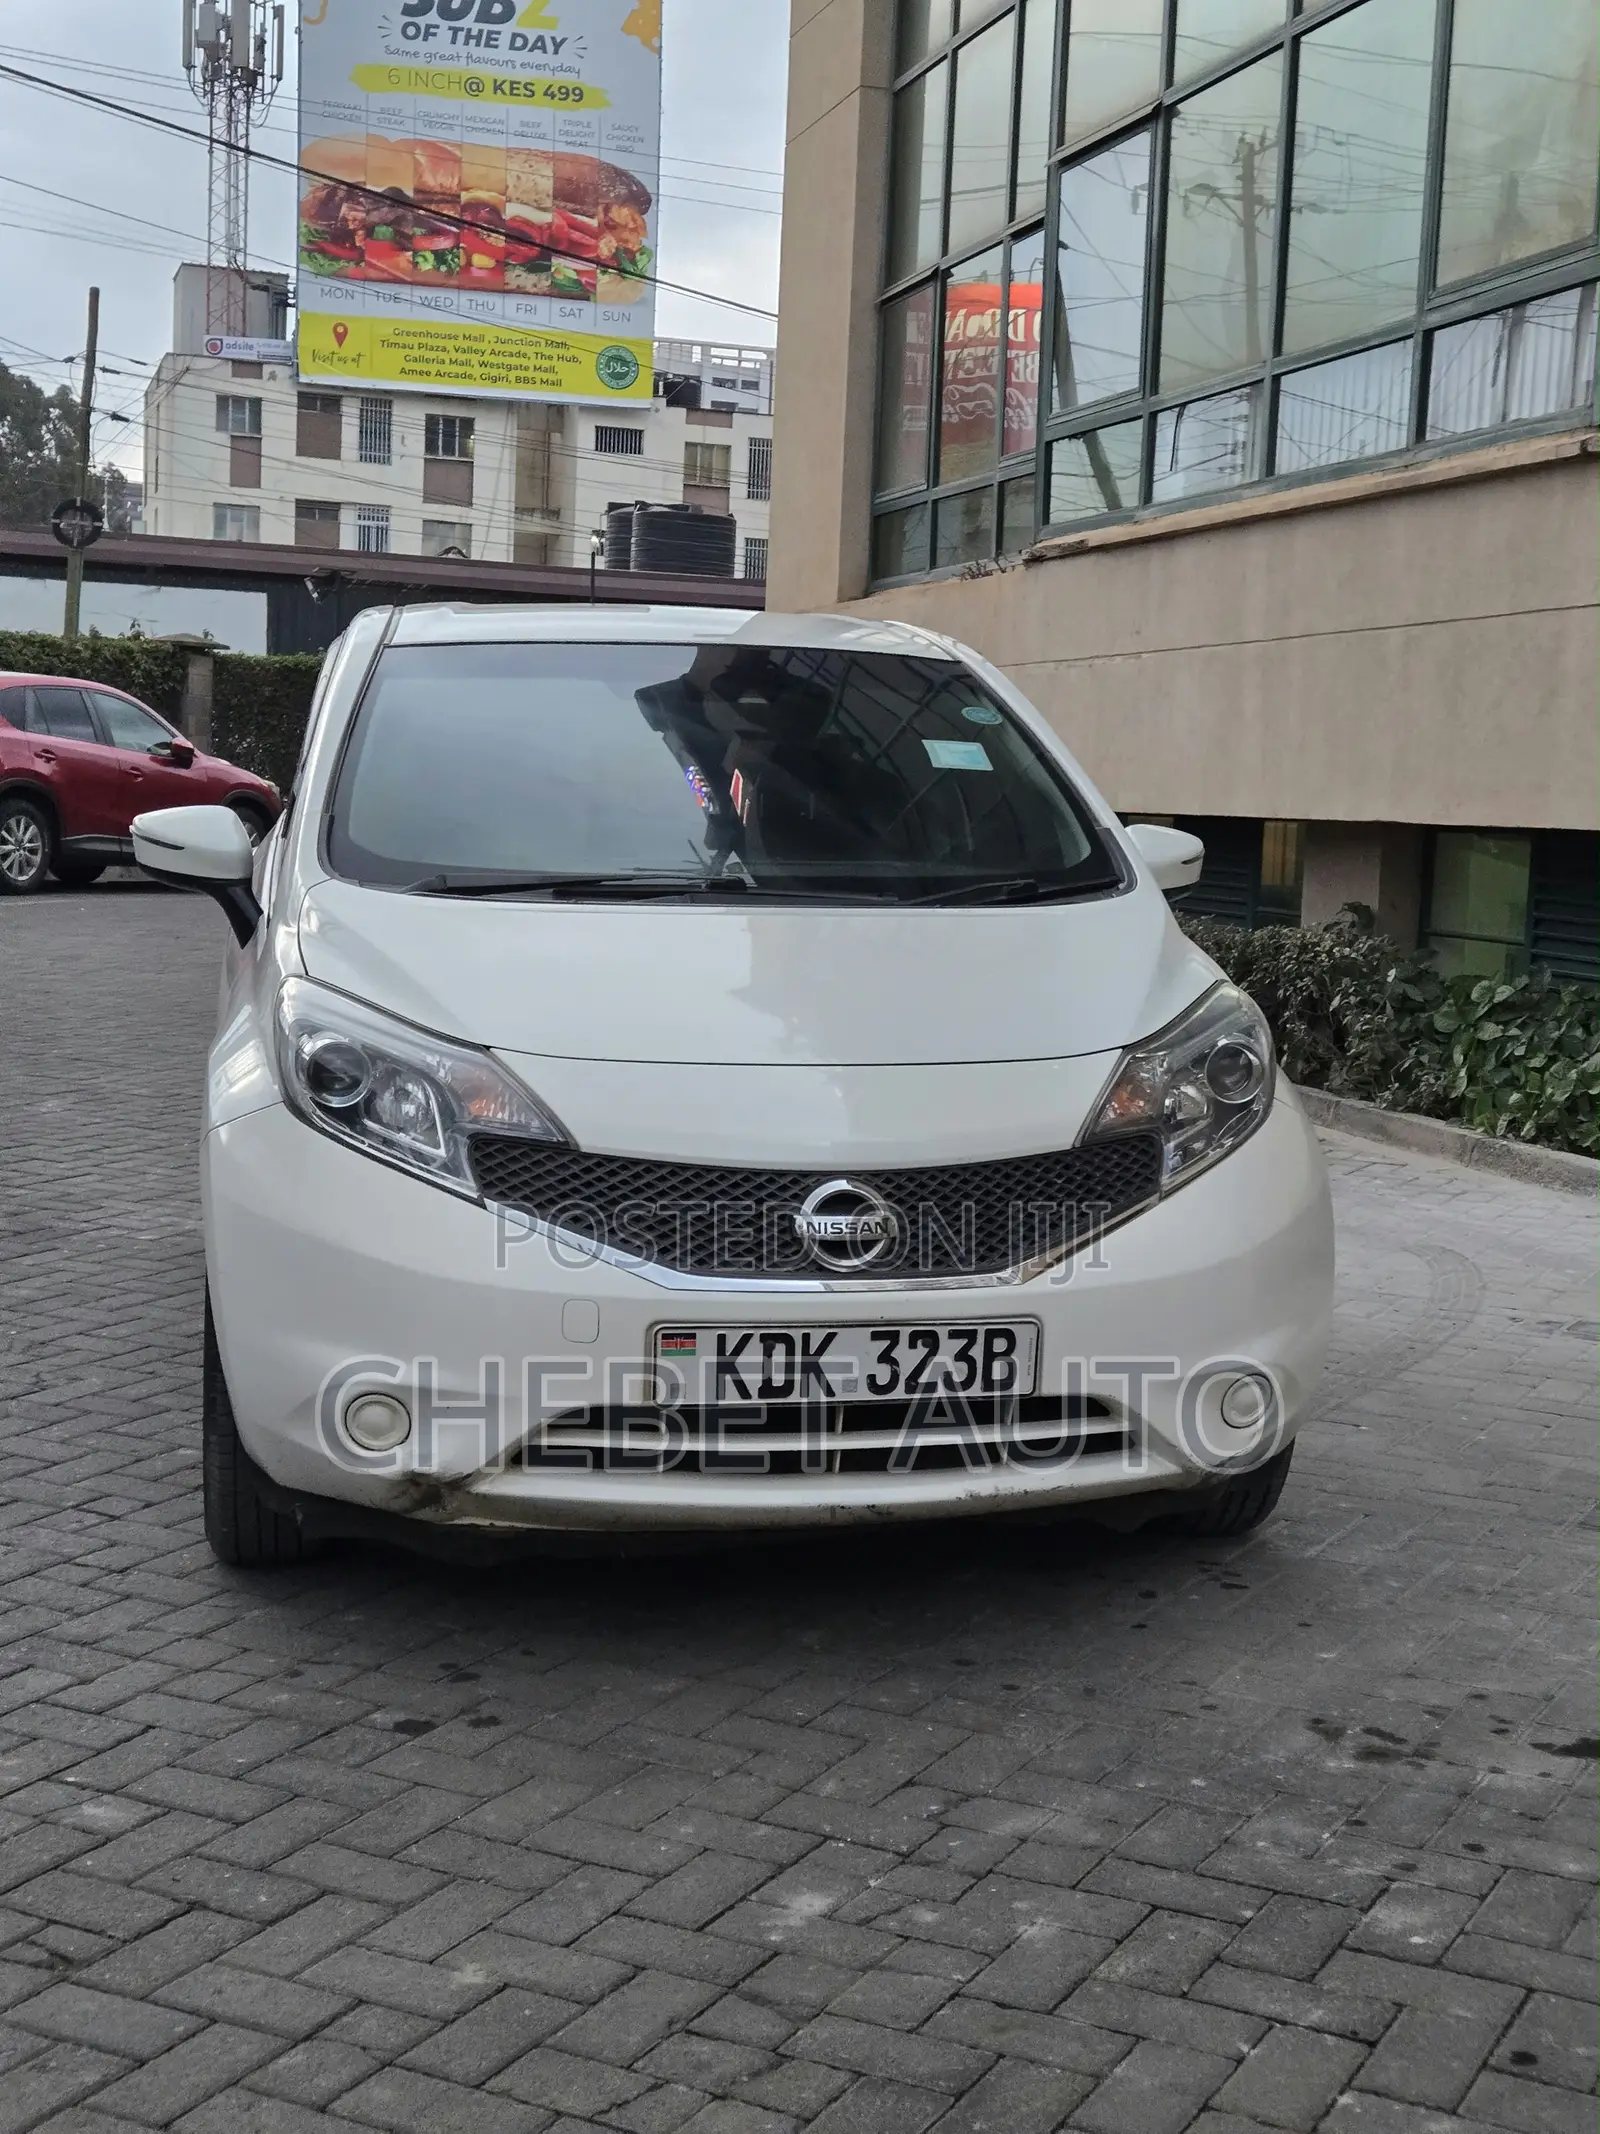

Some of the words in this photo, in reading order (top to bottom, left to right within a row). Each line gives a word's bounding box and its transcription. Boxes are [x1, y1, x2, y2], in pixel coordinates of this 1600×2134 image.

[400, 21, 440, 42] OF
[448, 25, 502, 49] THE
[508, 31, 569, 55] DAY
[424, 52, 463, 64] great
[465, 52, 517, 70] flavours
[520, 61, 581, 79] everyday
[387, 68, 400, 85] 6
[493, 78, 536, 99] KES
[543, 84, 585, 103] 499
[380, 107, 403, 116] BEEF
[417, 110, 460, 121] CRUNCHY
[377, 117, 405, 127] STEAK
[423, 120, 455, 132] VEGGIE
[465, 115, 505, 126] MEXICAN
[520, 120, 543, 129] BEEF
[563, 119, 593, 129] TRIPLE
[514, 130, 548, 140] DELUXE
[559, 129, 596, 139] DELIGHT
[611, 123, 641, 133] SAUCY
[606, 133, 645, 144] CHICKEN
[320, 287, 355, 301] MON
[375, 291, 403, 304] TUE
[419, 295, 454, 308] WED
[466, 299, 496, 312] THU
[515, 303, 537, 315] FRI
[559, 306, 584, 319] SAT
[602, 310, 632, 323] SUN
[392, 327, 460, 341] Greenhouse
[463, 333, 485, 343] Mall
[493, 336, 541, 348] Junction
[312, 348, 338, 366] Visit
[337, 353, 348, 364] us
[351, 352, 366, 369] at
[380, 339, 414, 350] Timau
[418, 342, 450, 354] Plaza,
[453, 345, 487, 357] Valley
[489, 348, 531, 360] Arcade,
[534, 351, 554, 361] The
[557, 354, 582, 364] Hub,
[404, 354, 446, 365] Galleria
[449, 358, 475, 368] Mall,
[477, 360, 530, 372] Westgate
[533, 364, 559, 375] Mall,
[399, 367, 432, 377] Amee
[435, 369, 477, 381] Arcade,
[480, 372, 512, 384] Gigiri,
[515, 375, 537, 385] BBS
[540, 378, 562, 387] Mall
[806, 1220, 890, 1236] NISSAN
[715, 1330, 839, 1400] KDK
[866, 1327, 1017, 1396] 323B
